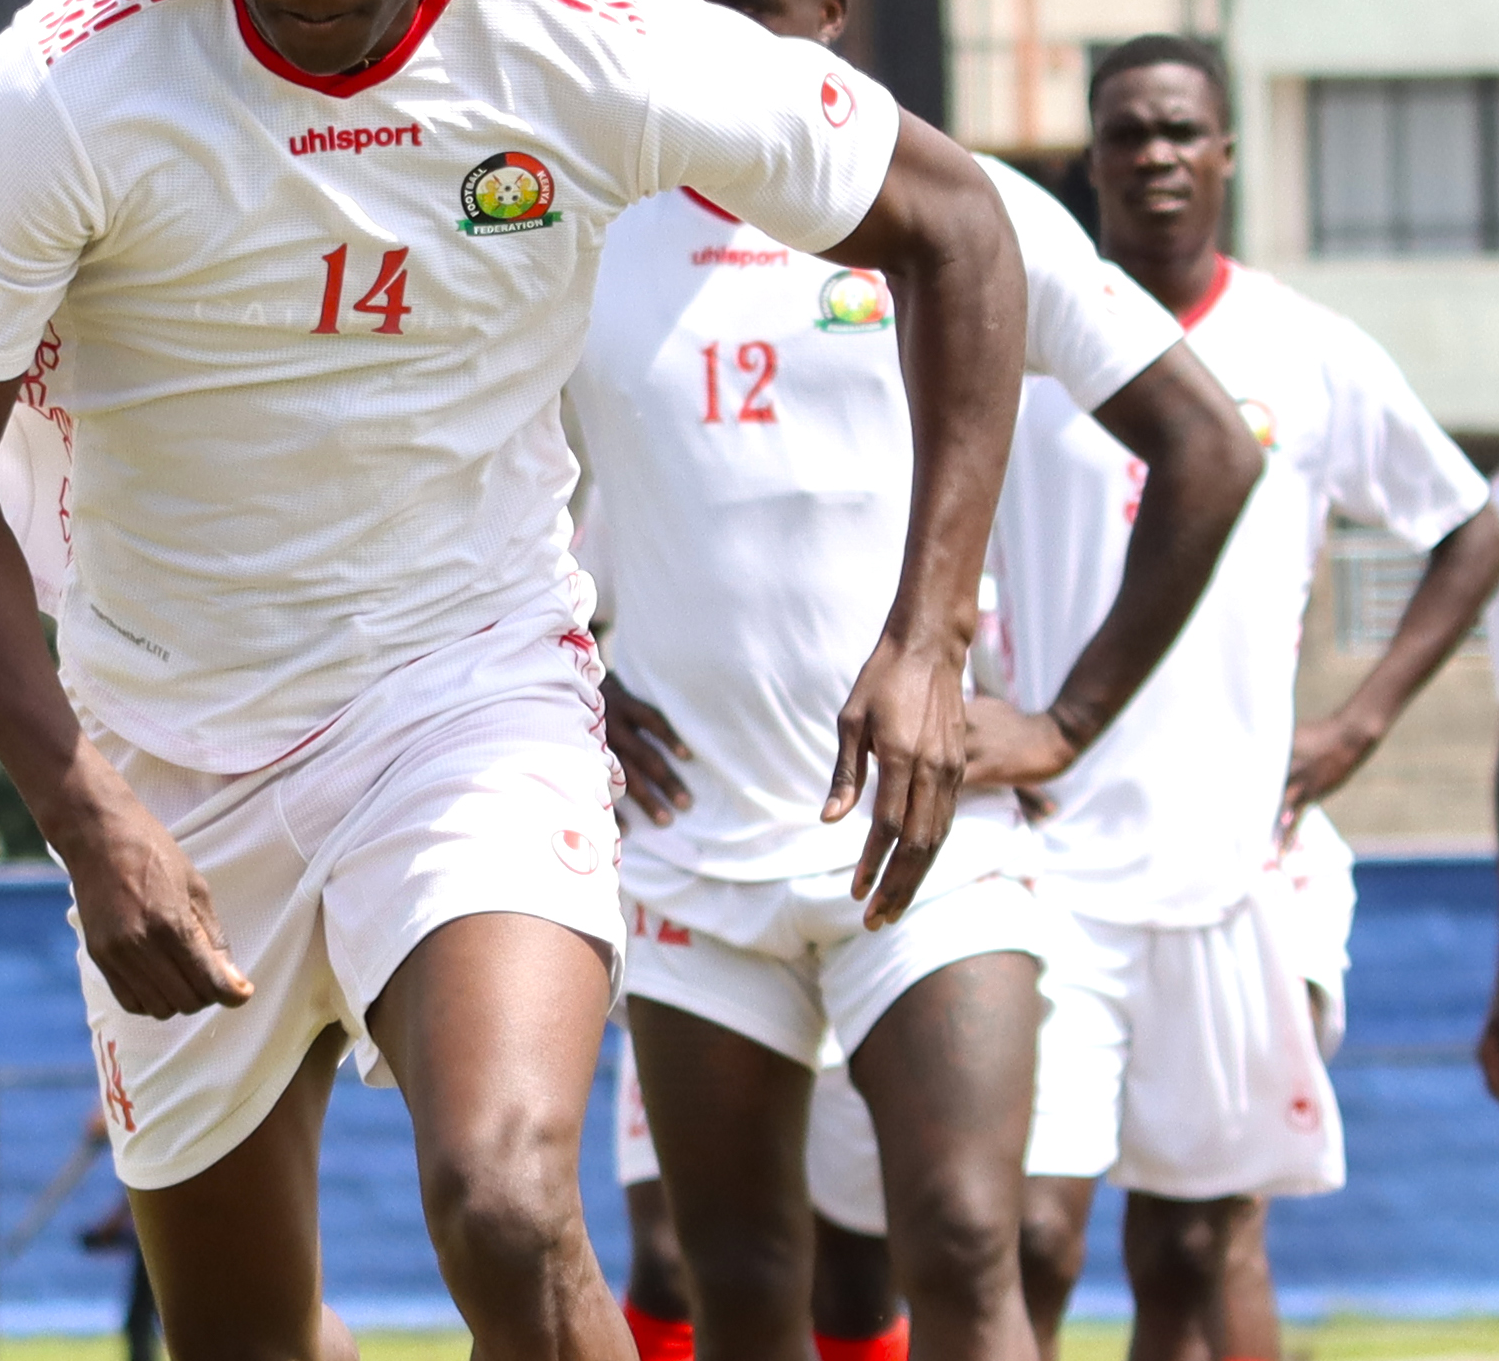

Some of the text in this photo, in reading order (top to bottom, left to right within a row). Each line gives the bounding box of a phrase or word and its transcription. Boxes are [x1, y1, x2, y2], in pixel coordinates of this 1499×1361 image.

[289, 123, 422, 155] uhlsport
[464, 167, 487, 218] FOOTBALL
[536, 169, 551, 205] KENYA
[473, 218, 544, 235] FEDERATION
[692, 245, 790, 268] uhlsport
[310, 243, 412, 335] 14
[701, 339, 780, 425] 12
[145, 640, 171, 663] LITE
[98, 1029, 137, 1133] 14
